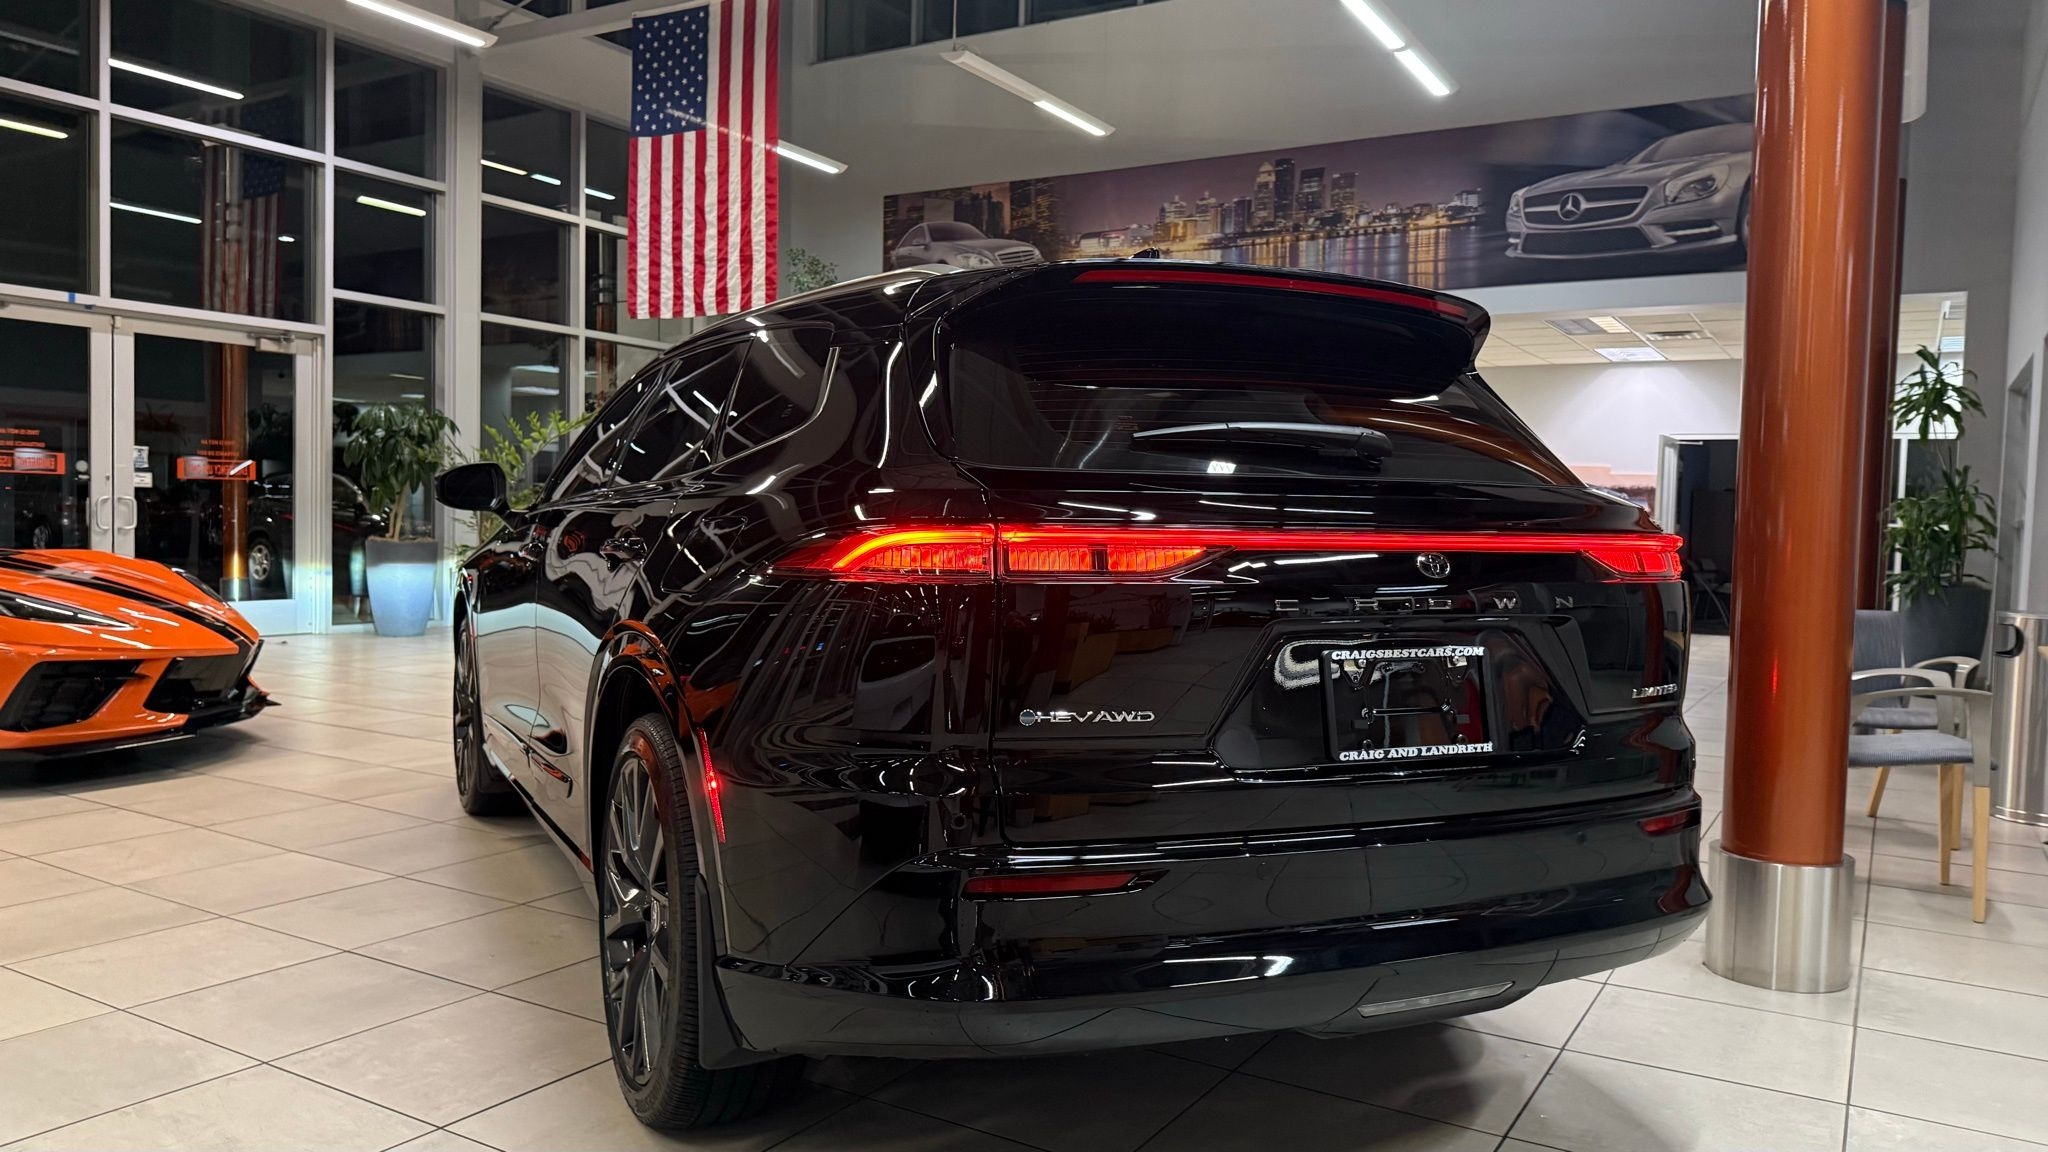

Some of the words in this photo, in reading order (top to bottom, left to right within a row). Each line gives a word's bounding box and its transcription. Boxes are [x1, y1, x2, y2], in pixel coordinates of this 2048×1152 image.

[1331, 646, 1485, 660] CRAIGSBESTCARS.COM
[1632, 683, 1678, 698] LIMITED
[1036, 710, 1093, 723] HEV
[1092, 710, 1155, 722] AWD
[1339, 749, 1385, 761] CRAIG
[1387, 747, 1419, 758] AND
[1421, 741, 1493, 755] LANDRETH
